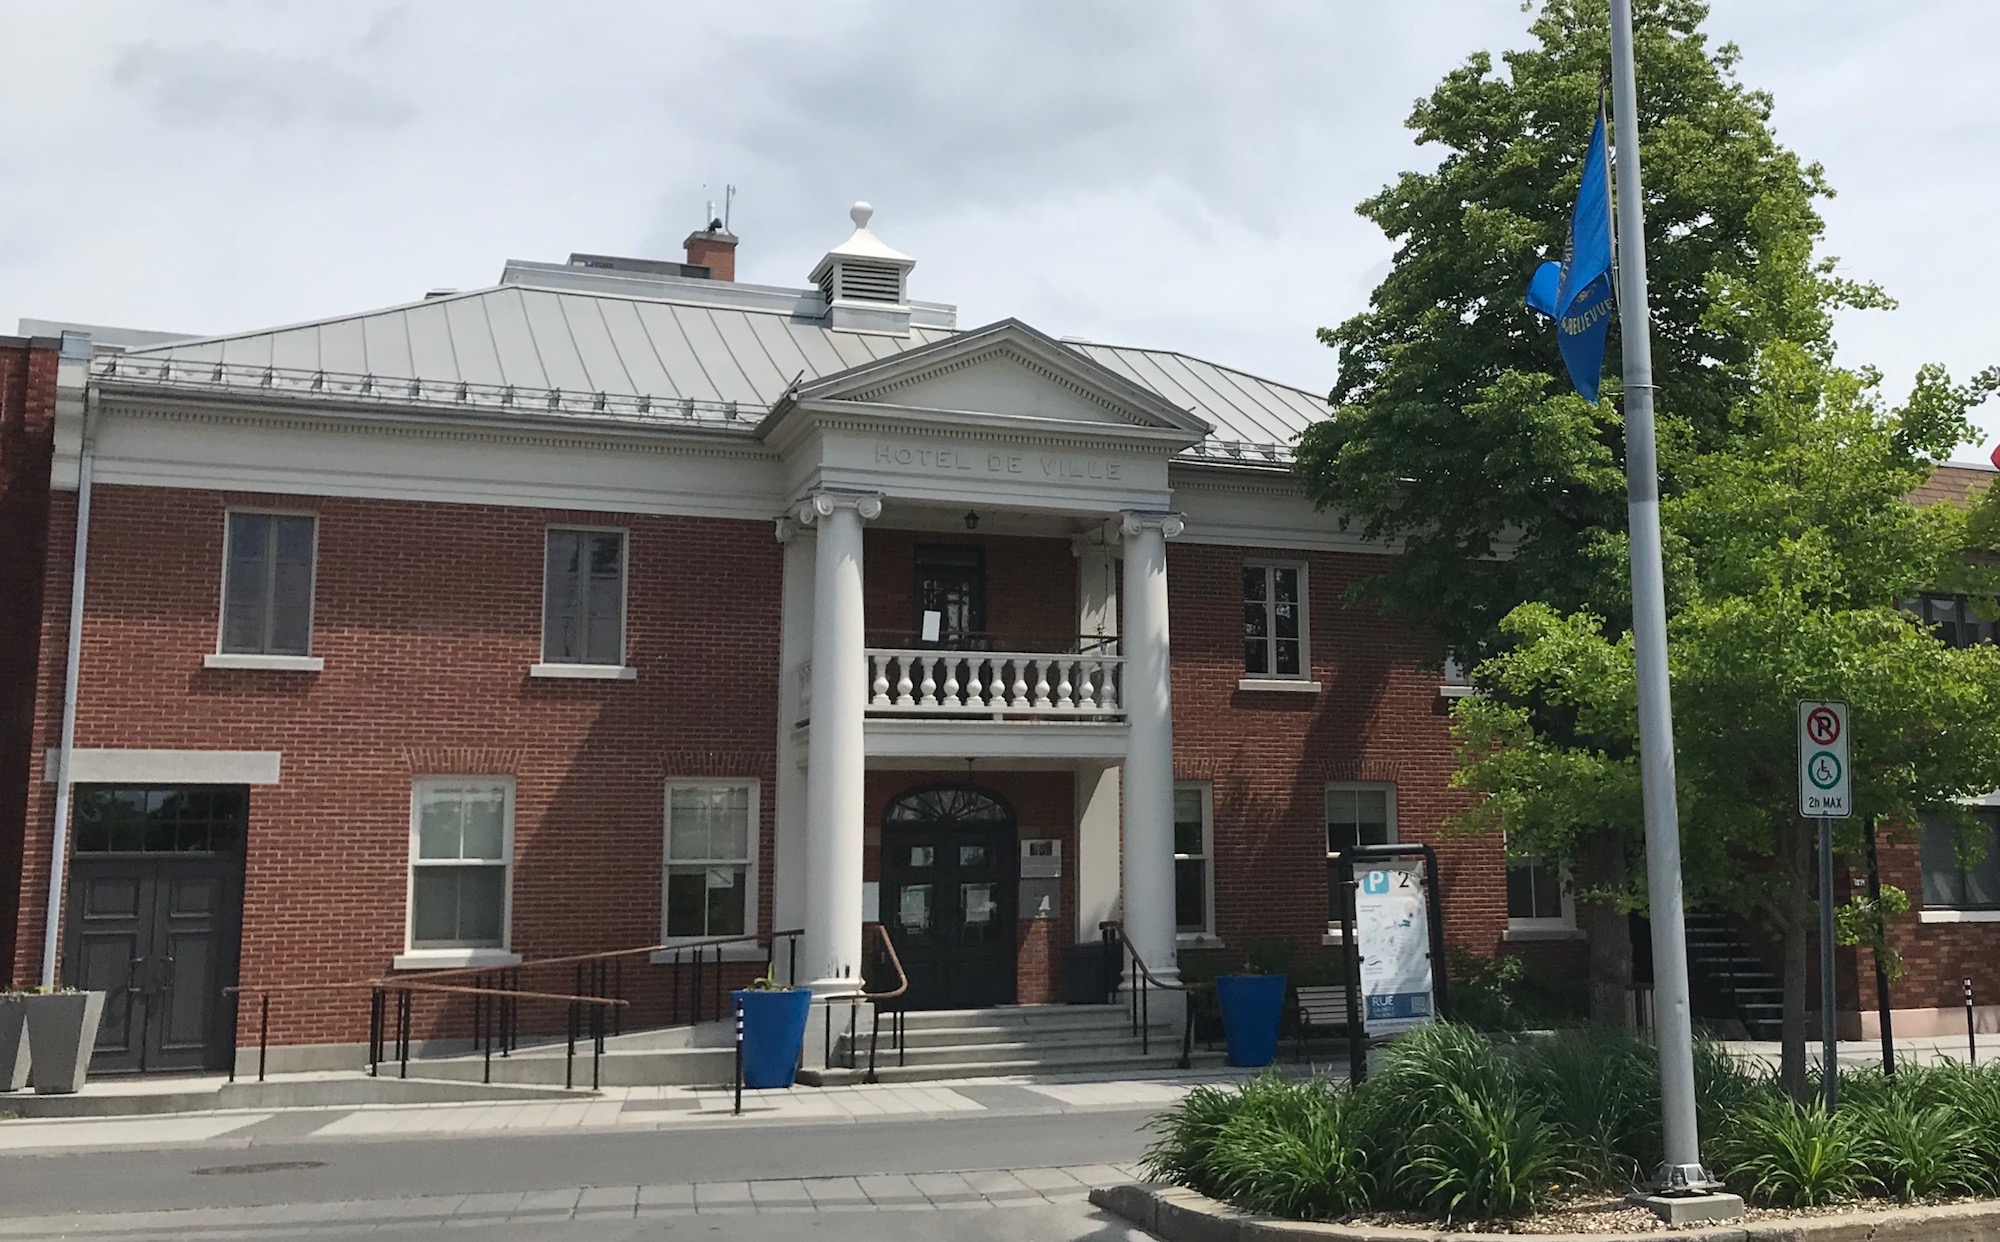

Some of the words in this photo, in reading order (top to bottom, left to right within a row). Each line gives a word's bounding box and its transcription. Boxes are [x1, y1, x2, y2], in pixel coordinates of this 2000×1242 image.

[875, 445, 971, 470] HOTEL
[988, 454, 1022, 474] DE
[1040, 457, 1121, 480] VILLE
[1808, 796, 1820, 808] 2h
[1823, 797, 1842, 808] MAX
[1369, 871, 1384, 892] P
[1371, 995, 1394, 1007] RUE
